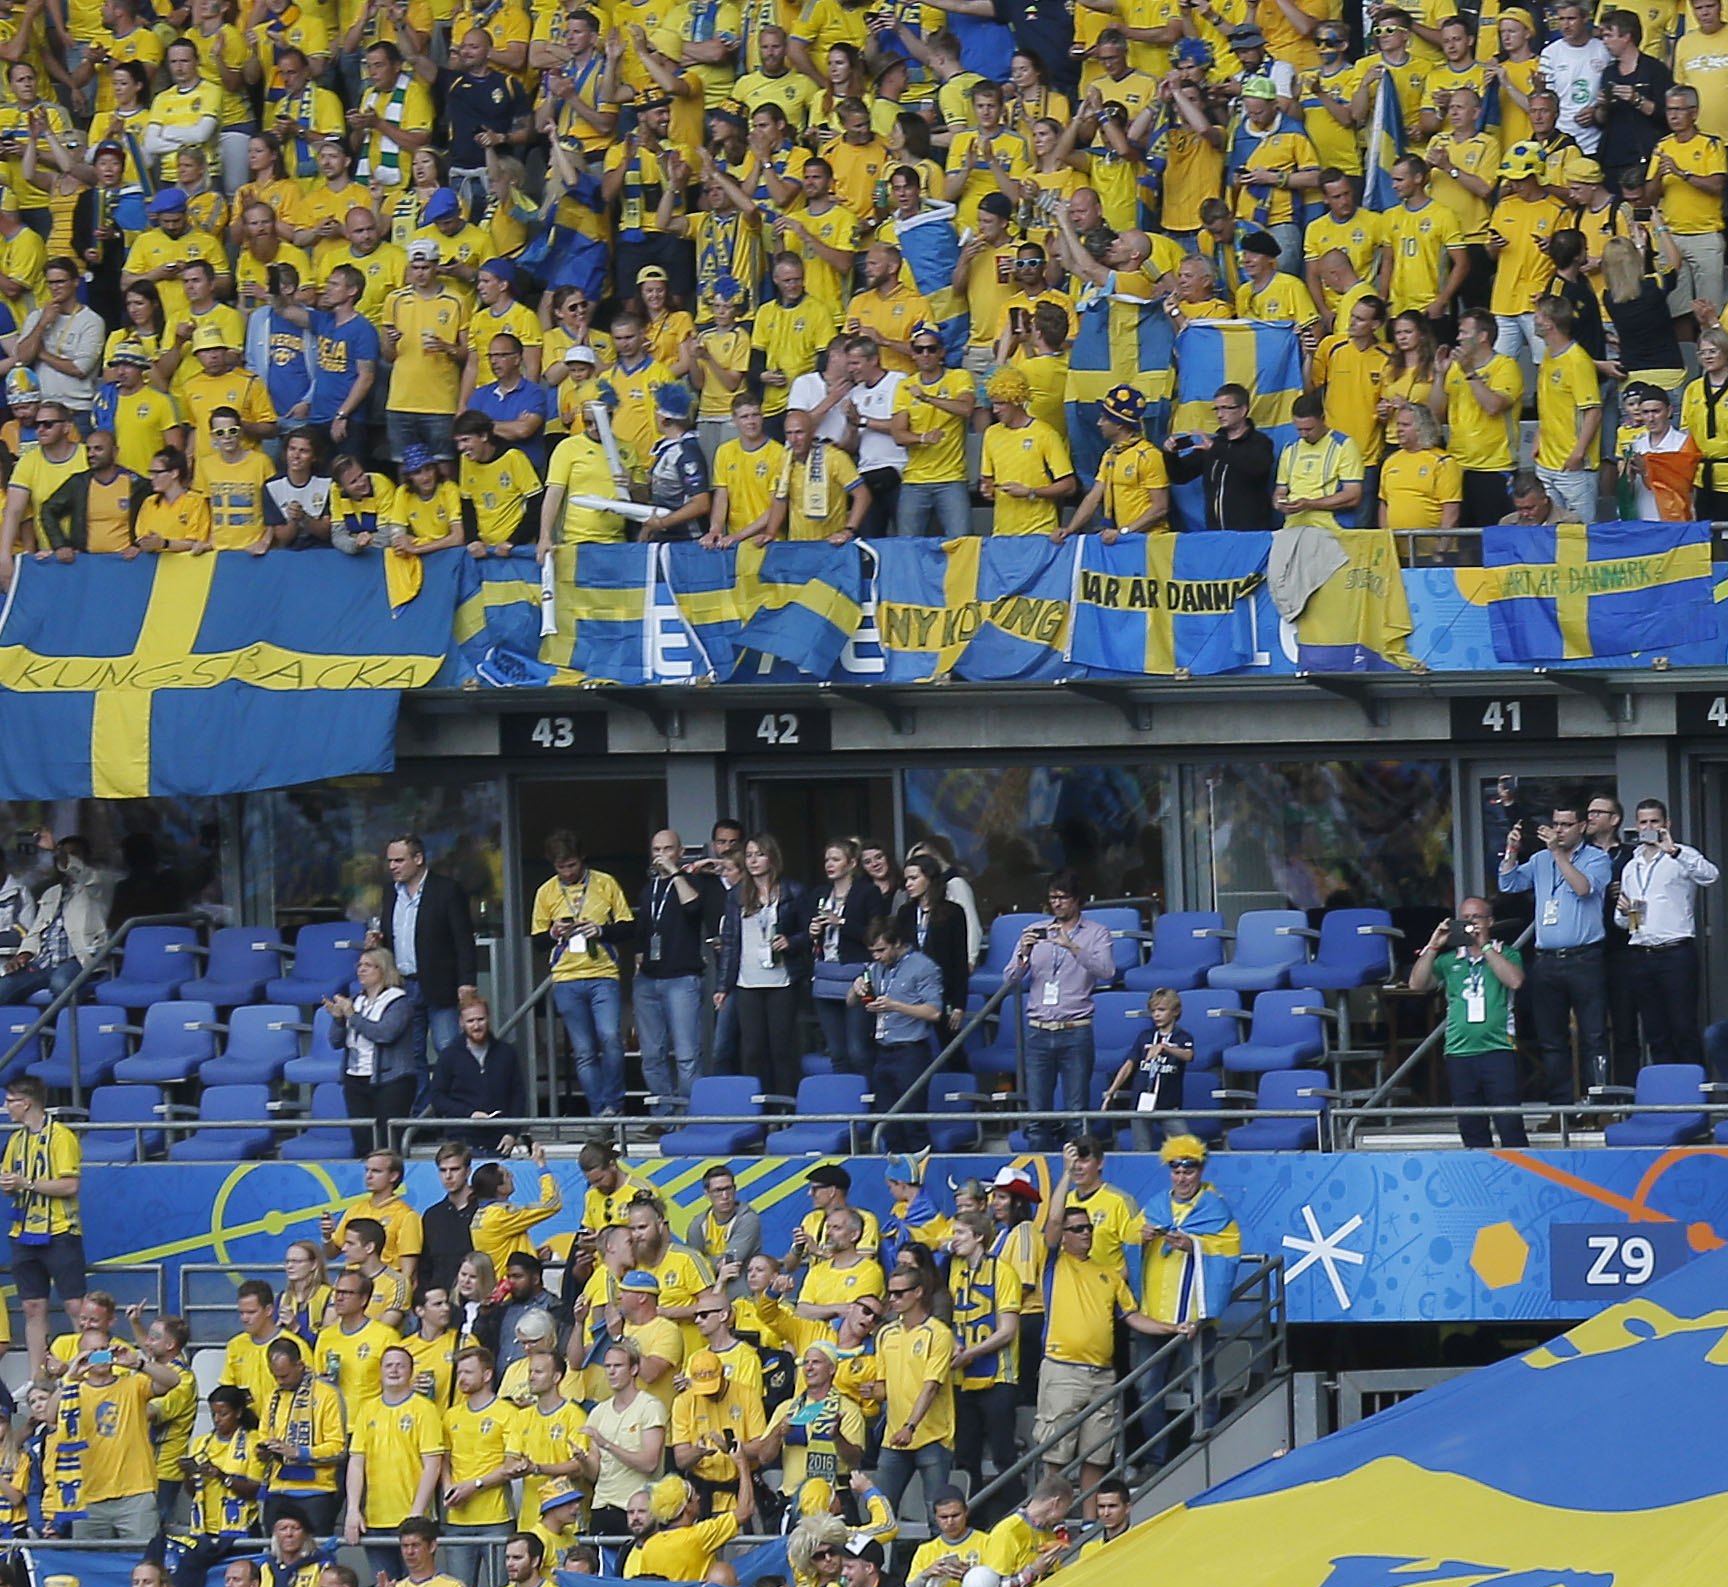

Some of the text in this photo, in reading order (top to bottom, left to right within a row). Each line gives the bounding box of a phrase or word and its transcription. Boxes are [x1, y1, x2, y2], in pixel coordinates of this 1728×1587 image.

[756, 713, 799, 744] 42
[1481, 701, 1522, 732] 41
[531, 717, 575, 748] 43
[1587, 1237, 1655, 1284] Z9
[808, 1454, 835, 1470] 2016
